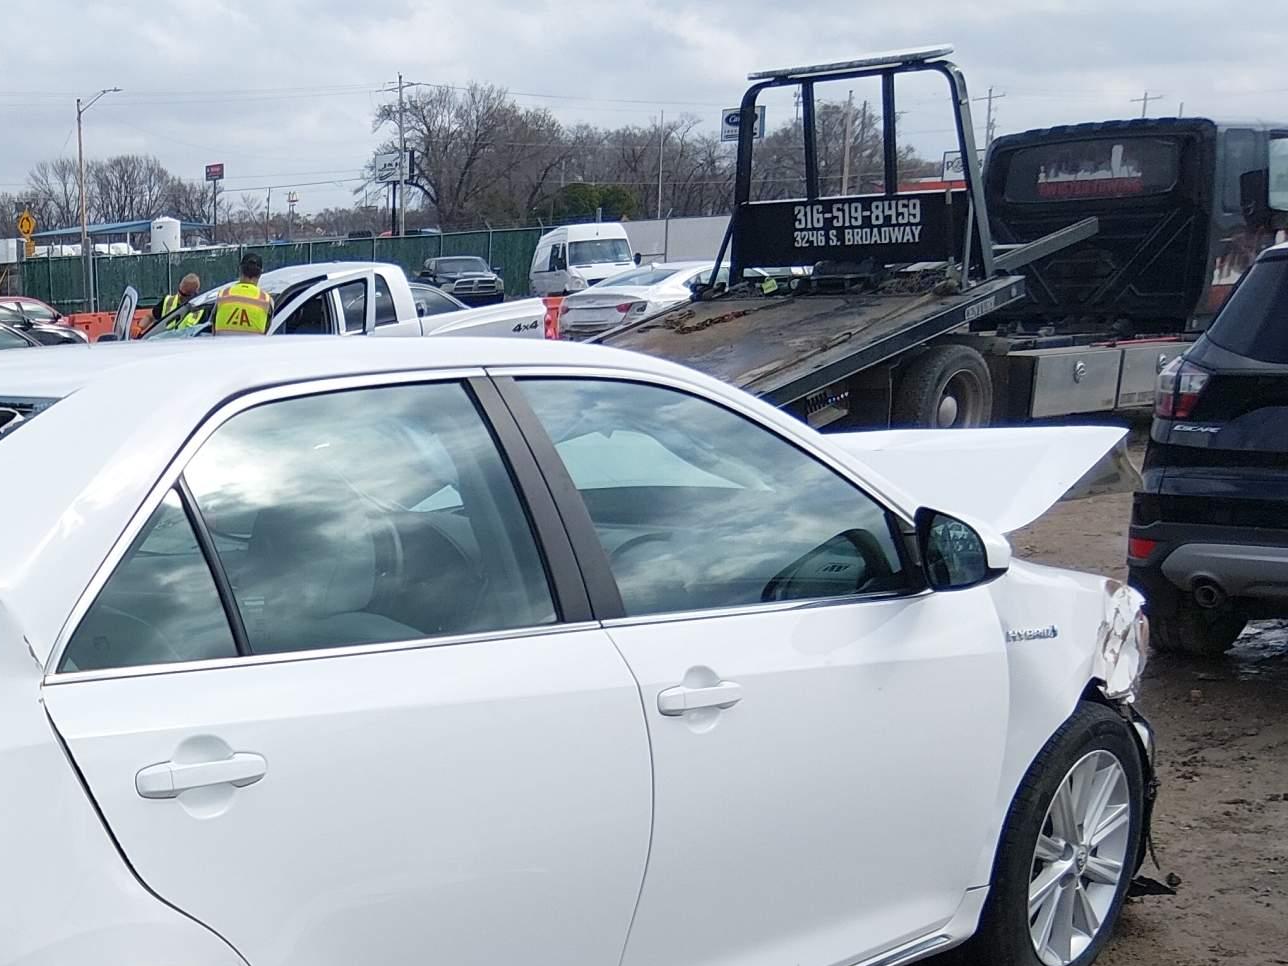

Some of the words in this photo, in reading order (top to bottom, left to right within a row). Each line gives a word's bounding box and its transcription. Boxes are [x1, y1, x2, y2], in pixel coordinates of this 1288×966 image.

[794, 199, 921, 229] 316-519-8459
[794, 230, 825, 248] 3246
[829, 229, 841, 246] S.
[844, 225, 923, 246] BROADWAY
